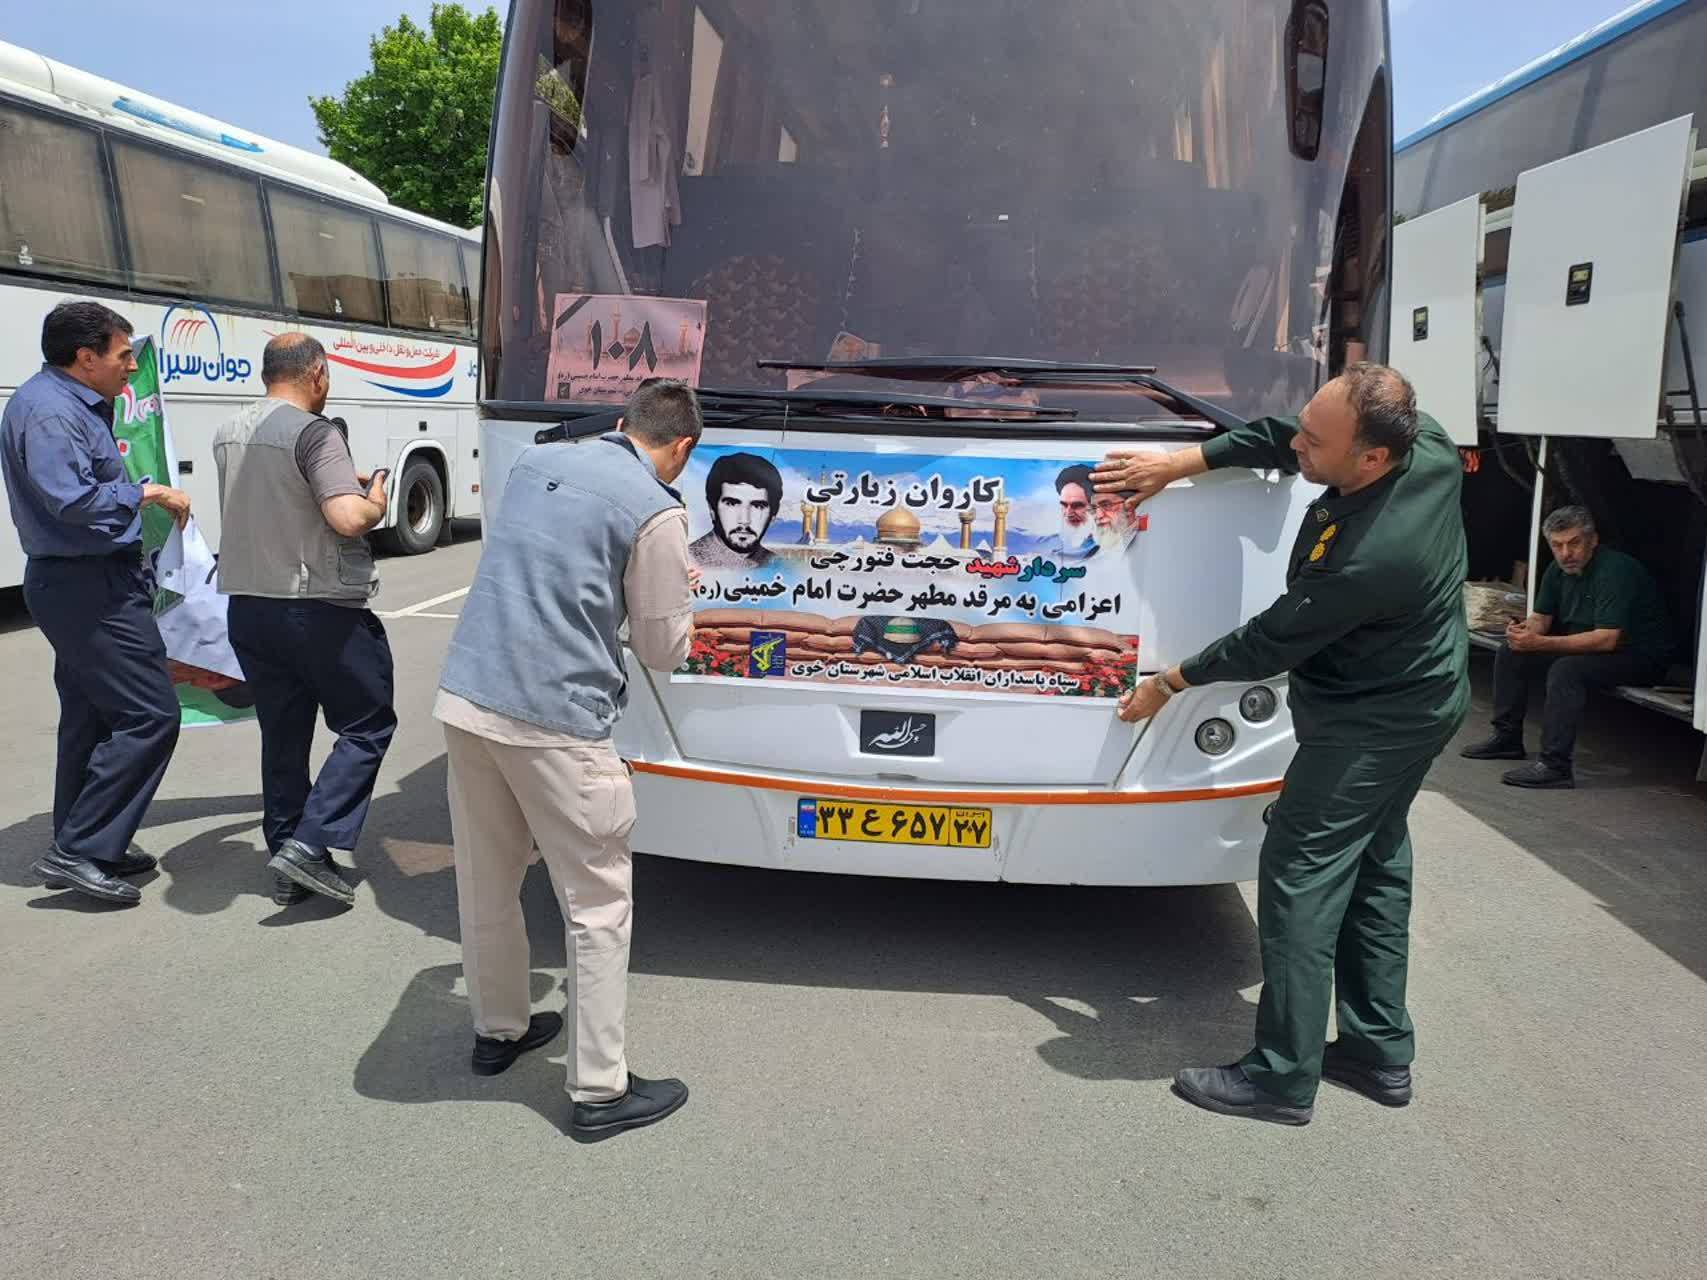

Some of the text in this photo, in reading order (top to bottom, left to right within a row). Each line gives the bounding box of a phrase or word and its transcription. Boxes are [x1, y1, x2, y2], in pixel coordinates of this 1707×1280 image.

[591, 320, 657, 373] ۱۰۸
[203, 353, 251, 384] جوان
[806, 473, 1000, 509] کاروان زیارتی
[810, 548, 1086, 583] سردار شهید حجت فتورچی
[724, 575, 786, 601] خمینی
[793, 577, 832, 605] امام
[837, 581, 904, 608] حضرت
[905, 584, 958, 611] مطهر
[963, 584, 1011, 616] مرقد
[1016, 594, 1037, 616] به
[1042, 593, 1121, 621] اعزامی
[792, 661, 824, 677] خوی
[828, 663, 885, 680] شهرستان
[888, 667, 936, 683] اسلامی
[940, 669, 981, 686] انقلاب
[984, 671, 1045, 690] پاسداران
[1048, 673, 1078, 689] سپاه
[818, 806, 855, 835] ۳۳
[861, 808, 883, 837] ع
[891, 810, 946, 841] ۶۵۷
